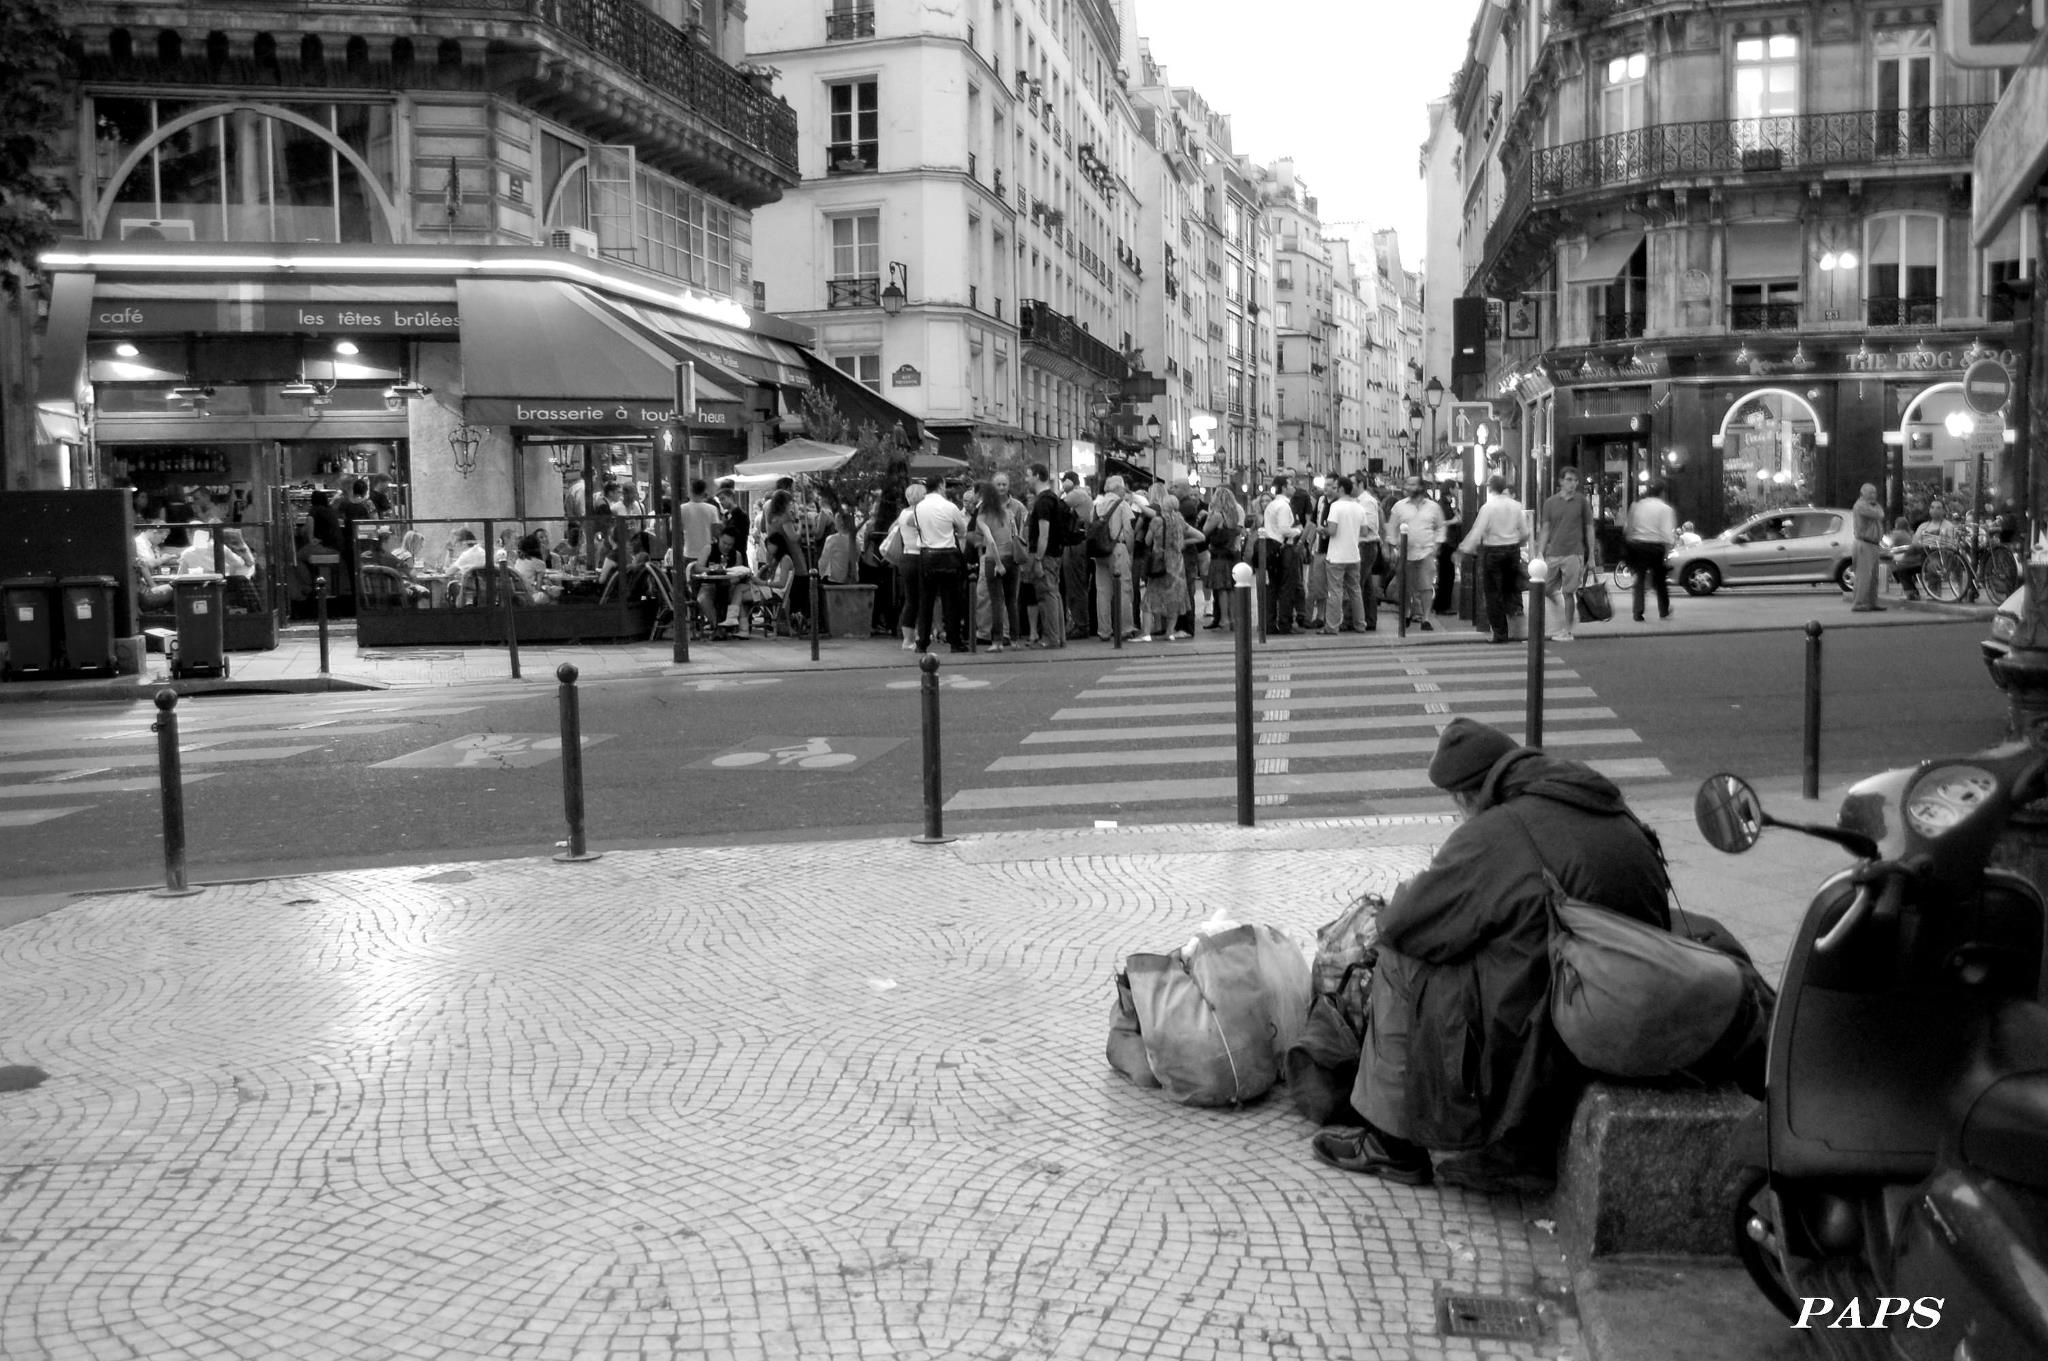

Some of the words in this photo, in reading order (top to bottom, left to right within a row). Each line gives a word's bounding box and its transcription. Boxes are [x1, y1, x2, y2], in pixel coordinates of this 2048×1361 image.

[100, 307, 144, 324] café
[298, 308, 325, 326] les
[338, 310, 382, 326] têtes
[394, 310, 463, 327] brûlées
[1846, 352, 1887, 370] THE
[1896, 350, 1953, 369] FROG
[517, 404, 604, 421] brasserie
[615, 405, 629, 420] à
[641, 408, 678, 423] tout
